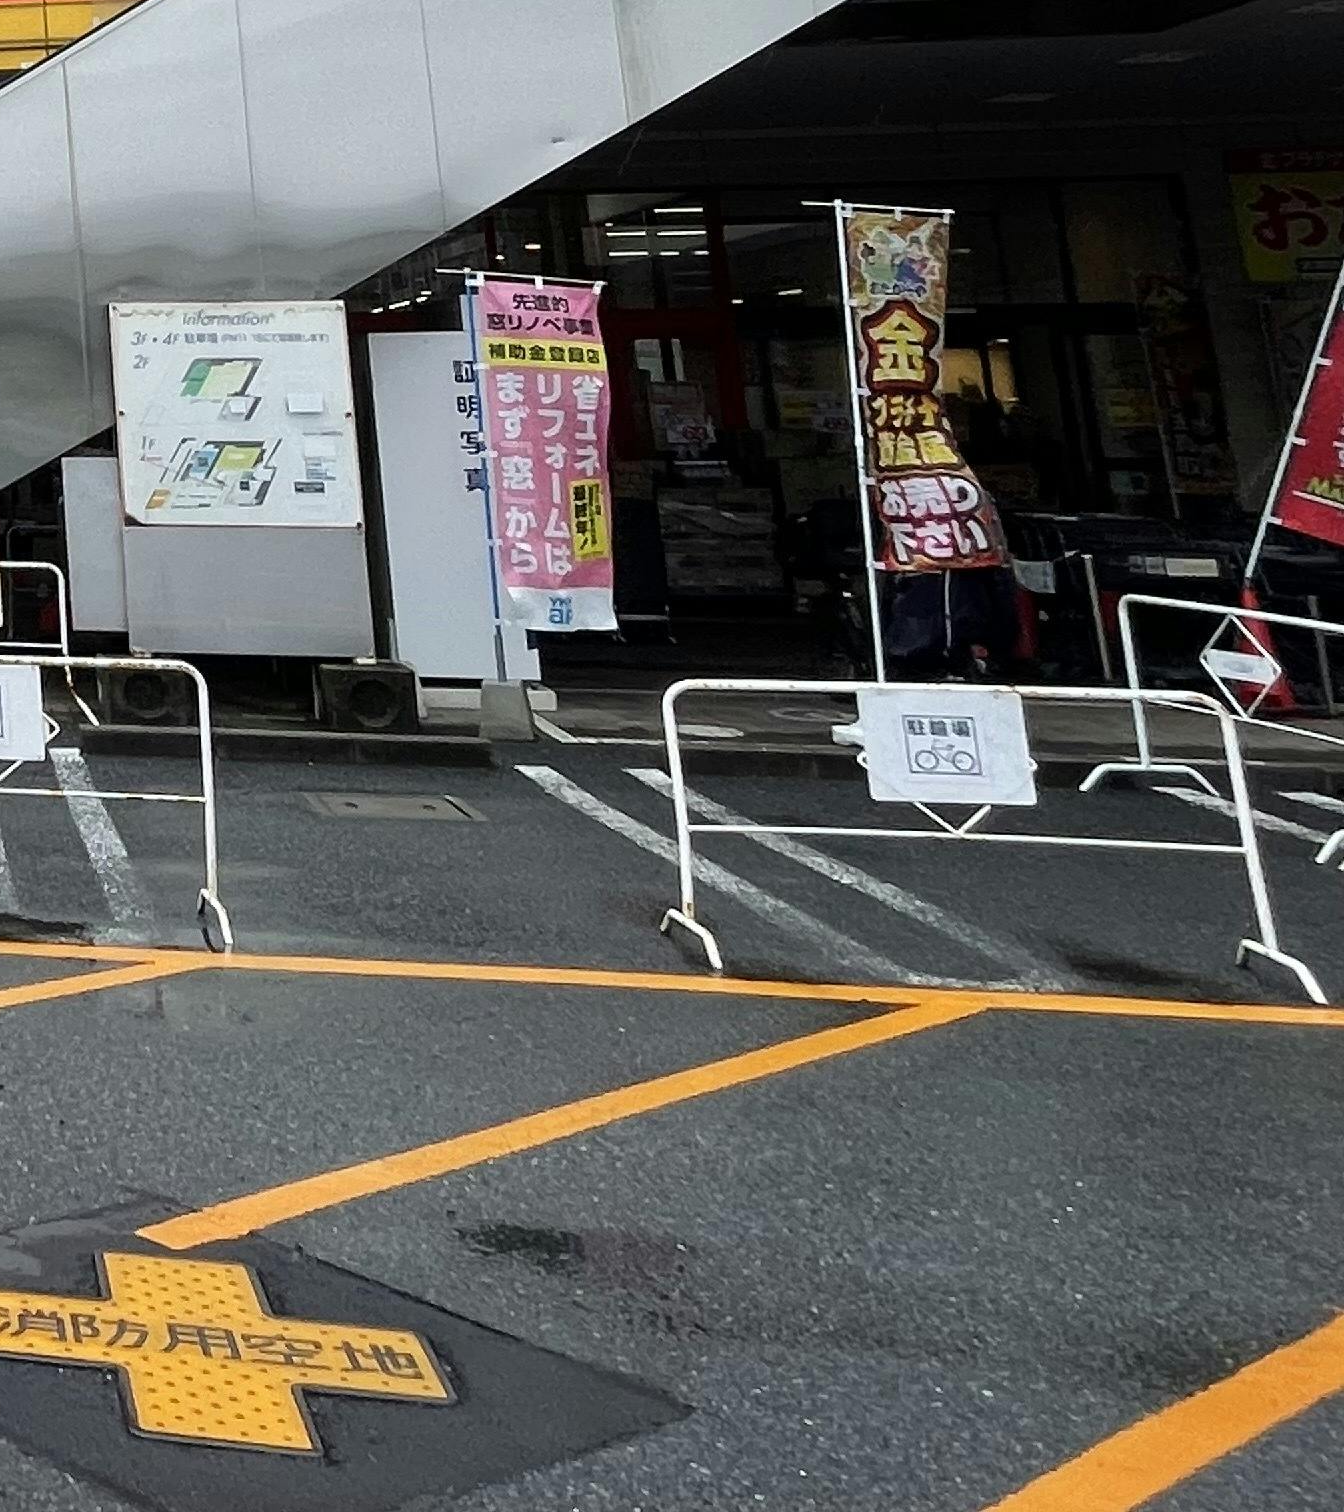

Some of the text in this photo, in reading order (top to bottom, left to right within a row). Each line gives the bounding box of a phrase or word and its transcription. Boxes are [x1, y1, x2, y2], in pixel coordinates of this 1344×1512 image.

[512, 293, 570, 314] 先進的
[868, 309, 929, 383] 金
[571, 374, 604, 477] 省エネ
[536, 373, 572, 576] リフォームは
[888, 519, 989, 563] 下さい
